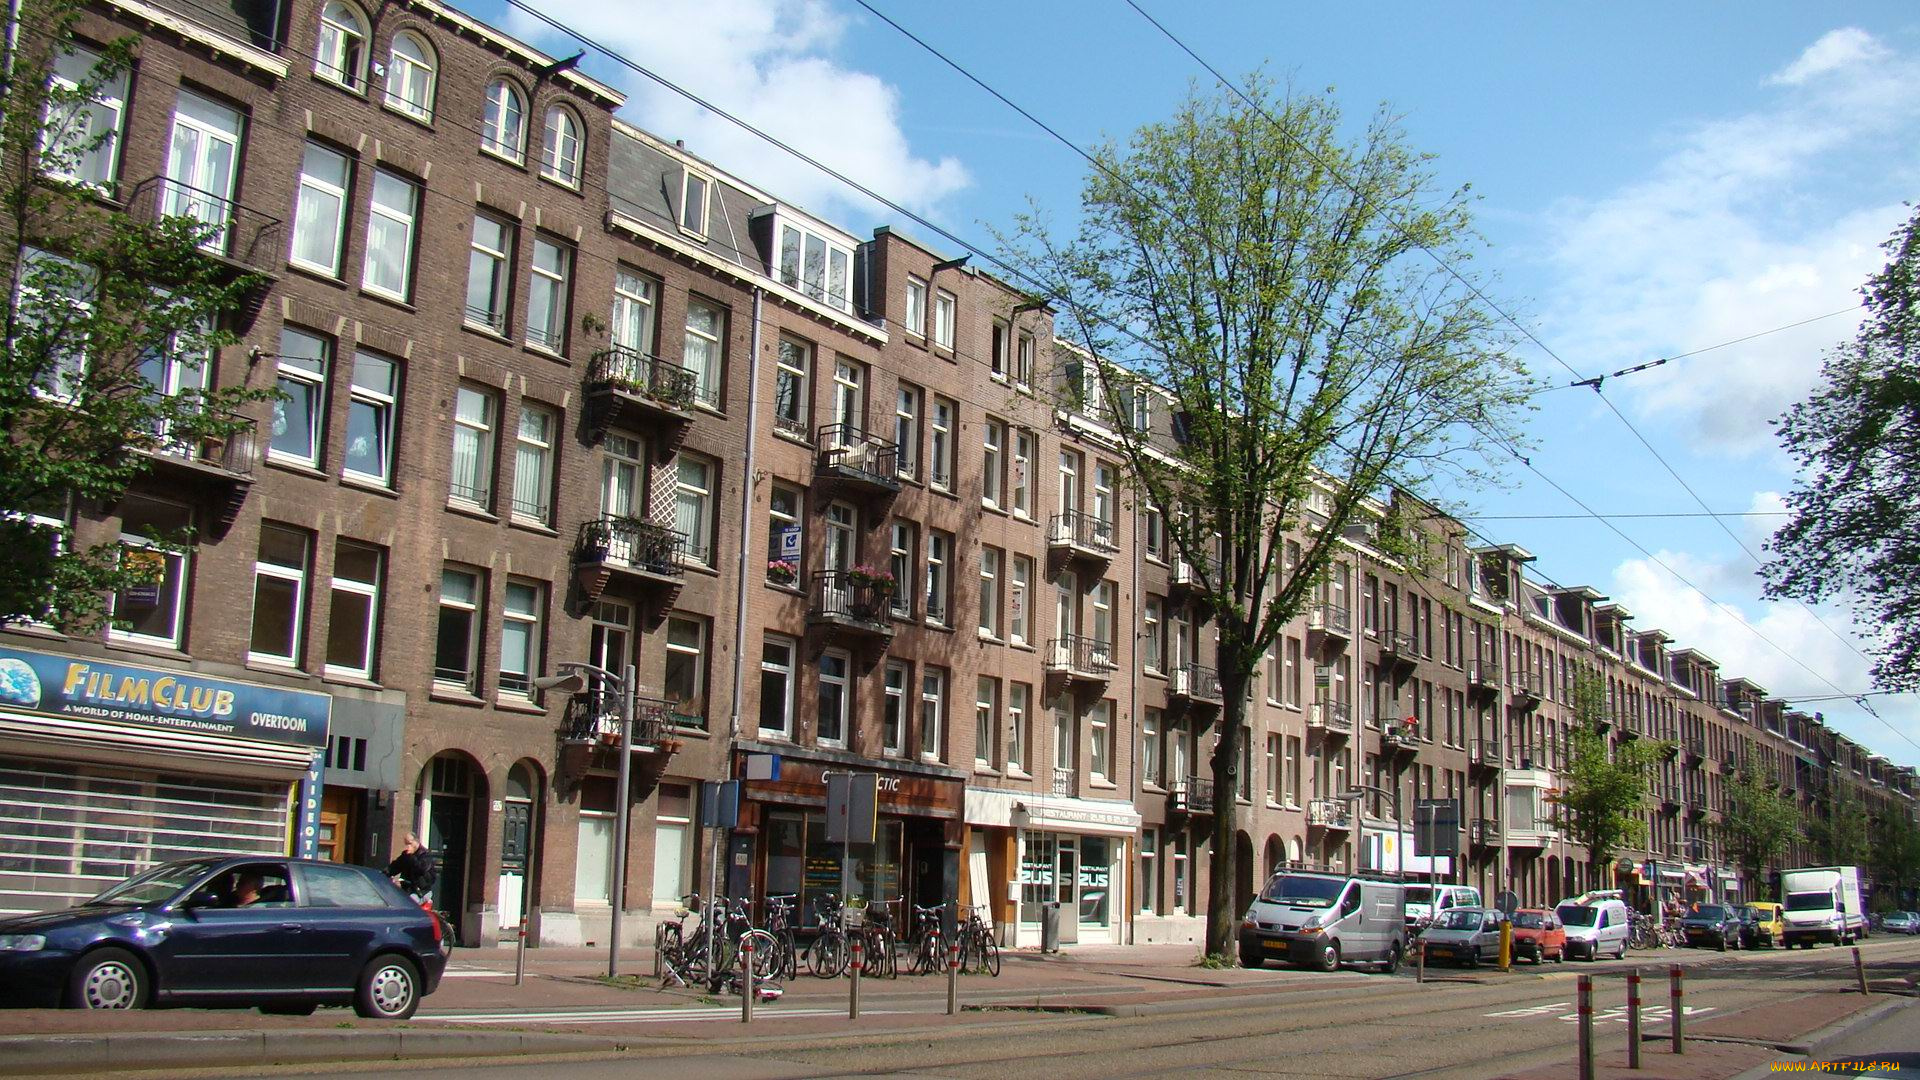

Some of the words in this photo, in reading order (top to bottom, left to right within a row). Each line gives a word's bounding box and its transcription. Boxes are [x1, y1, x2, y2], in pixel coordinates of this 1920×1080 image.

[62, 662, 235, 716] FILMCLUB
[63, 704, 72, 712] A
[73, 705, 110, 717] WORLD
[110, 710, 125, 719] OF
[125, 711, 235, 733] HOME-ENTERTAINMENT
[250, 712, 307, 732] OVERTOOM
[1041, 808, 1087, 820] RESTAURANT
[1022, 870, 1053, 885] ZUS
[1080, 872, 1109, 887] ZUS
